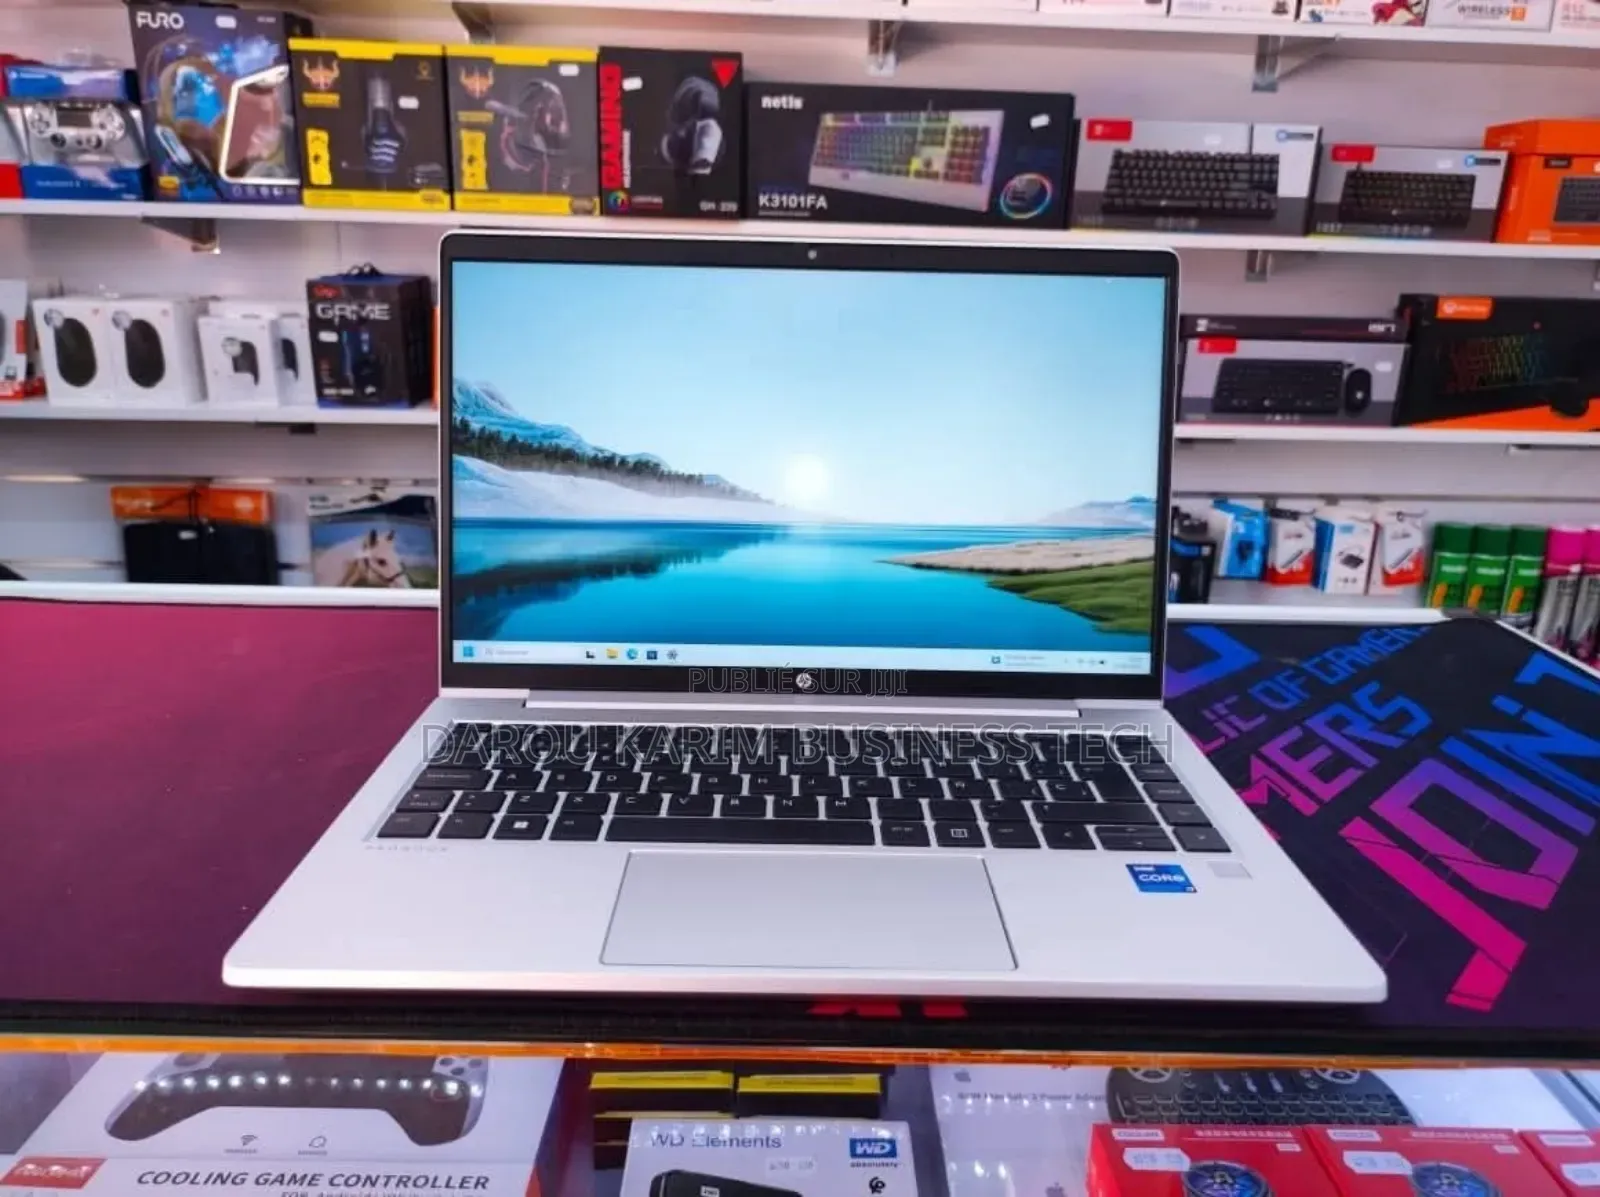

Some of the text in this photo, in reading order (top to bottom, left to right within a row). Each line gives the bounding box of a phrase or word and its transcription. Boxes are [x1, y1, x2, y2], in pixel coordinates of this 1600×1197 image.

[136, 11, 184, 29] FURO
[761, 95, 803, 110] netis
[600, 63, 623, 189] GAMING
[758, 193, 828, 210] K3101FA
[316, 303, 391, 326] GAME
[692, 1134, 782, 1149] Elements
[855, 1141, 892, 1155] WD
[137, 1171, 490, 1190] COOLING GAME CONTROLLER
